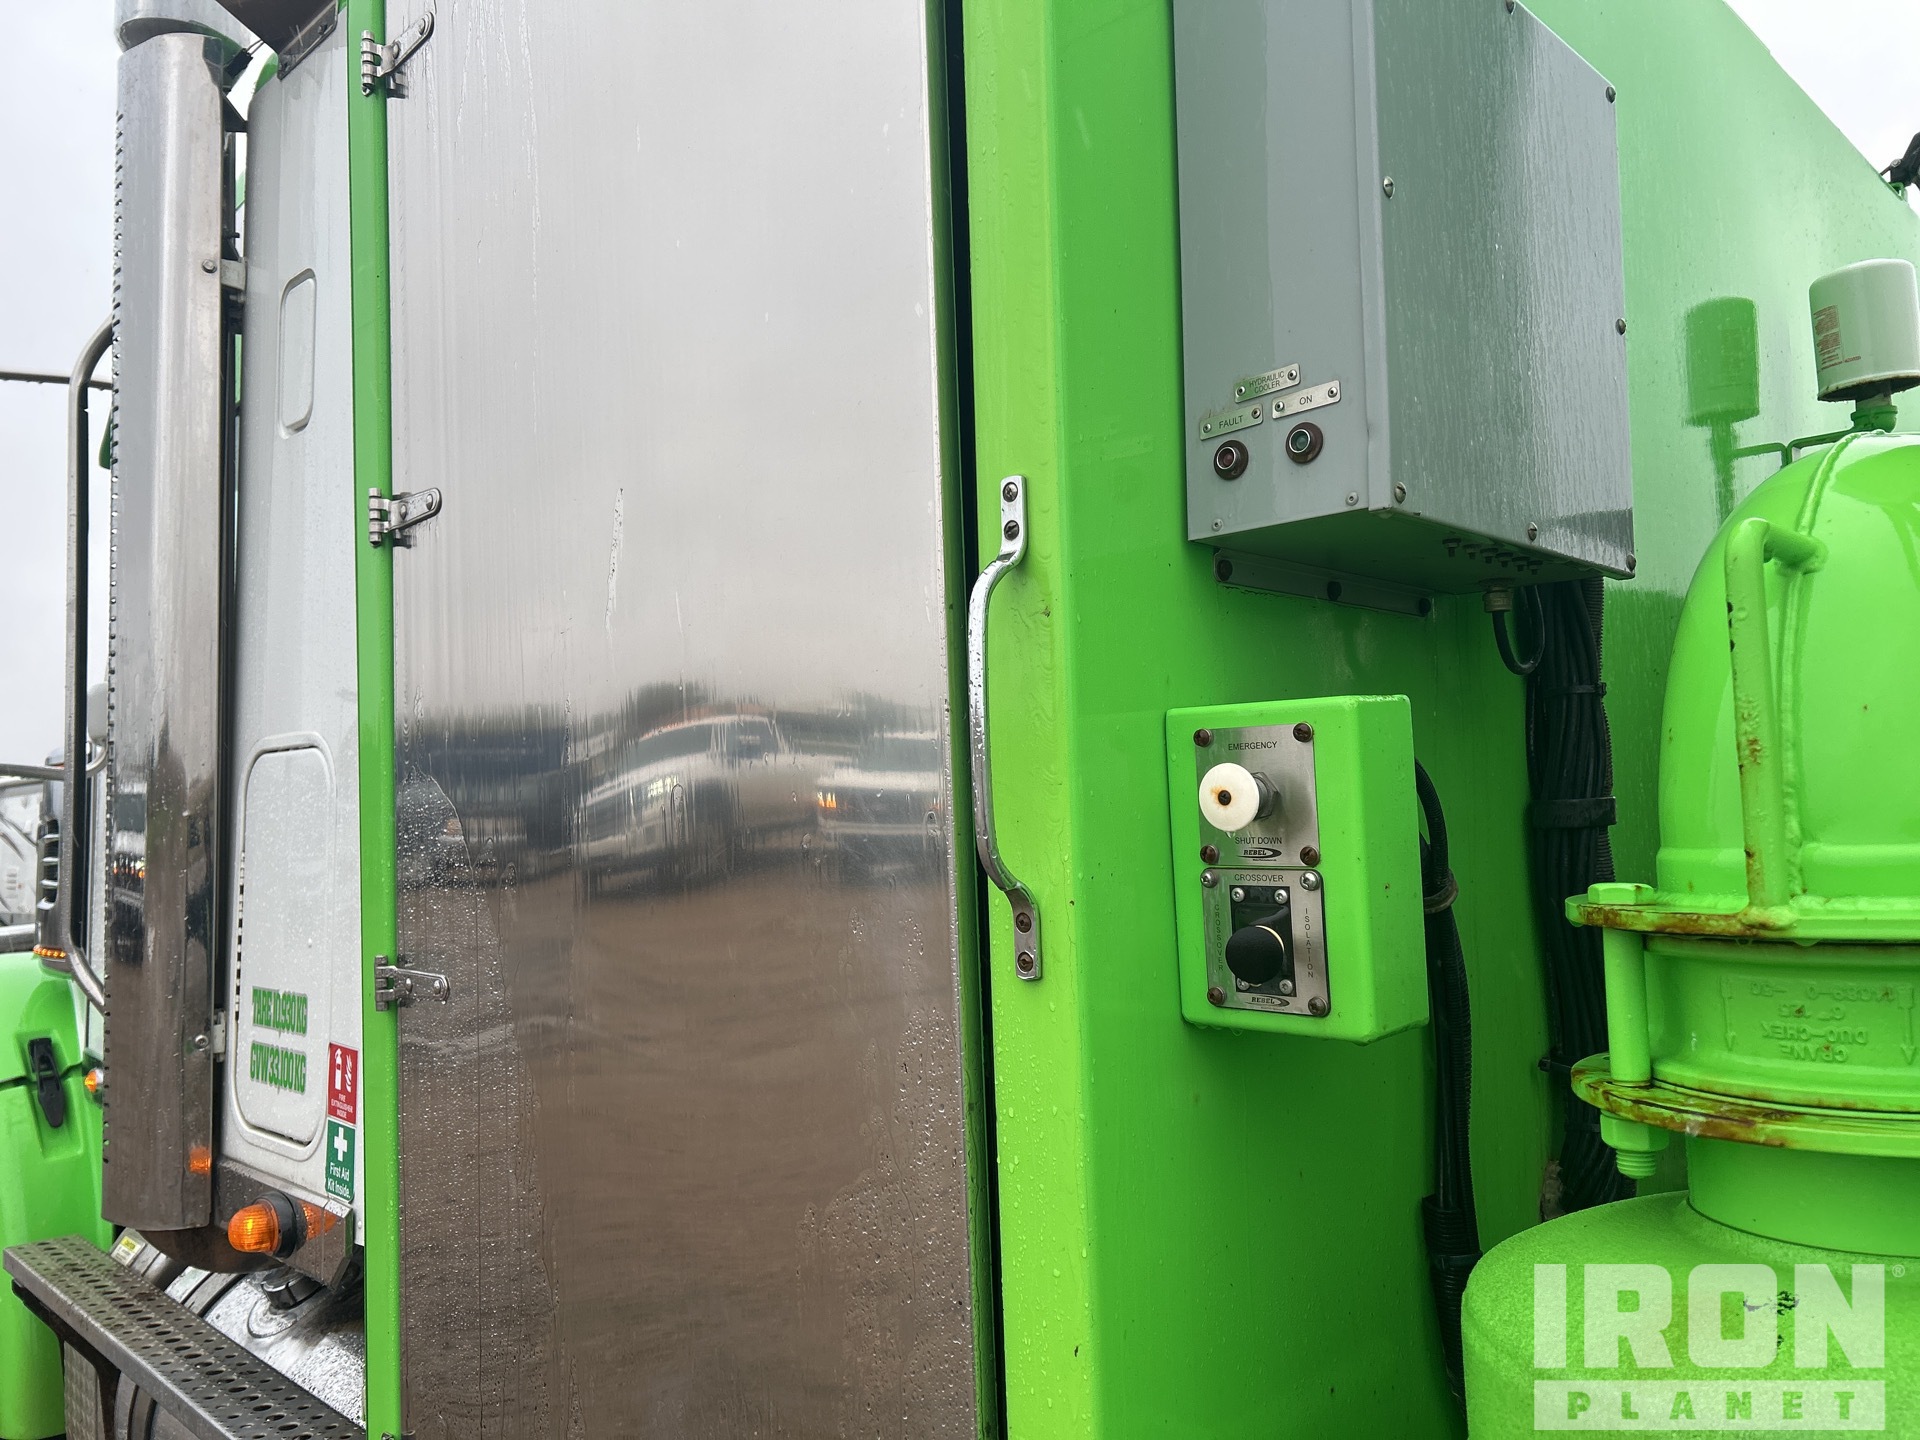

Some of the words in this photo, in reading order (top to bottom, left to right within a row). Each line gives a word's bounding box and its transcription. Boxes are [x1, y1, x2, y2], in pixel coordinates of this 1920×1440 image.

[1249, 371, 1285, 388] HYDRAULIC
[1254, 380, 1280, 394] COOLER
[1299, 395, 1313, 406] ON
[1218, 415, 1244, 429] FAULT
[1228, 741, 1278, 751] EMERGENCY
[1235, 837, 1256, 845] SHUT
[1258, 837, 1282, 845] DOWN
[1234, 874, 1284, 882] CROSSOVER
[1214, 904, 1224, 971] CROSSOVER
[1304, 908, 1314, 978] ISOLATION
[1251, 996, 1275, 1004] REBEL
[252, 987, 272, 1027] TARE
[296, 994, 308, 1035] KG
[250, 1042, 270, 1083] GVW
[293, 1052, 306, 1094] KG
[329, 1161, 341, 1178] First
[341, 1166, 350, 1182] Aid
[327, 1177, 335, 1192] Kit
